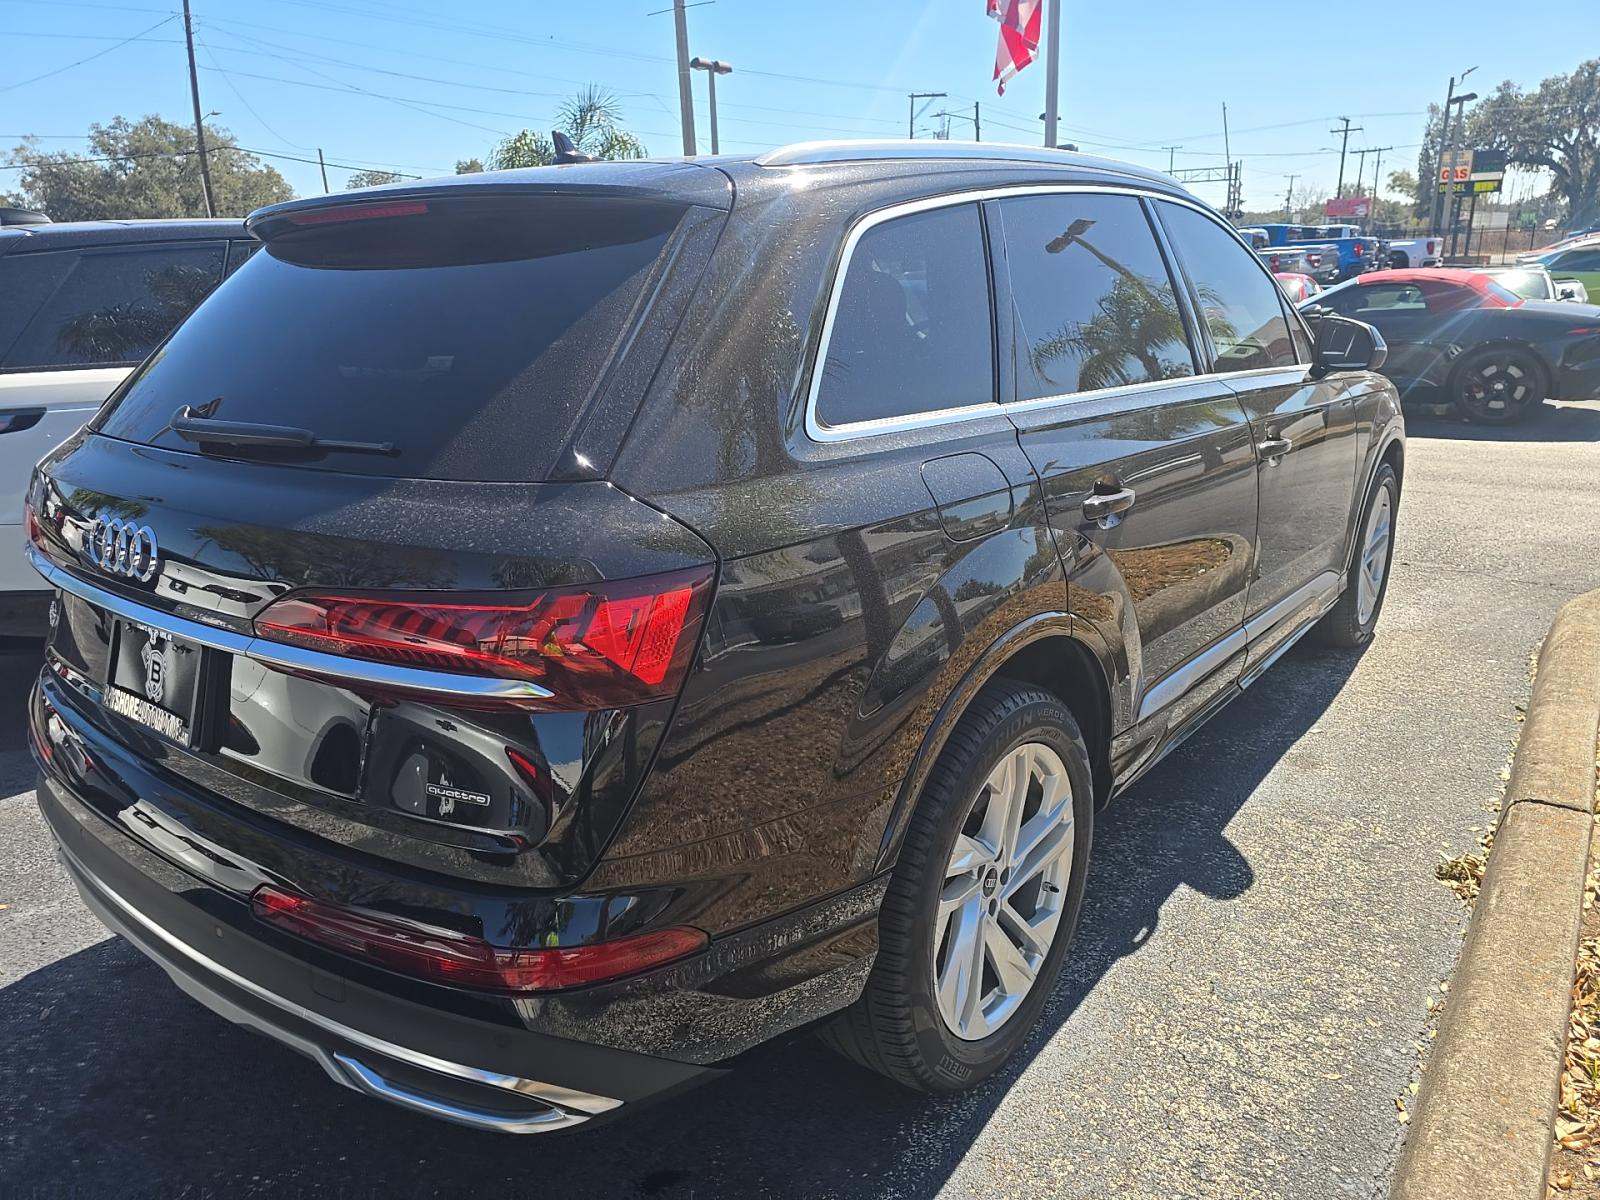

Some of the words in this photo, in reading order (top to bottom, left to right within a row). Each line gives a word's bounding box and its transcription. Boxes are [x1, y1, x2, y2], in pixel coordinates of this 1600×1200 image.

[1439, 182, 1466, 193] DISEL
[151, 659, 161, 683] B
[428, 786, 486, 803] quattro
